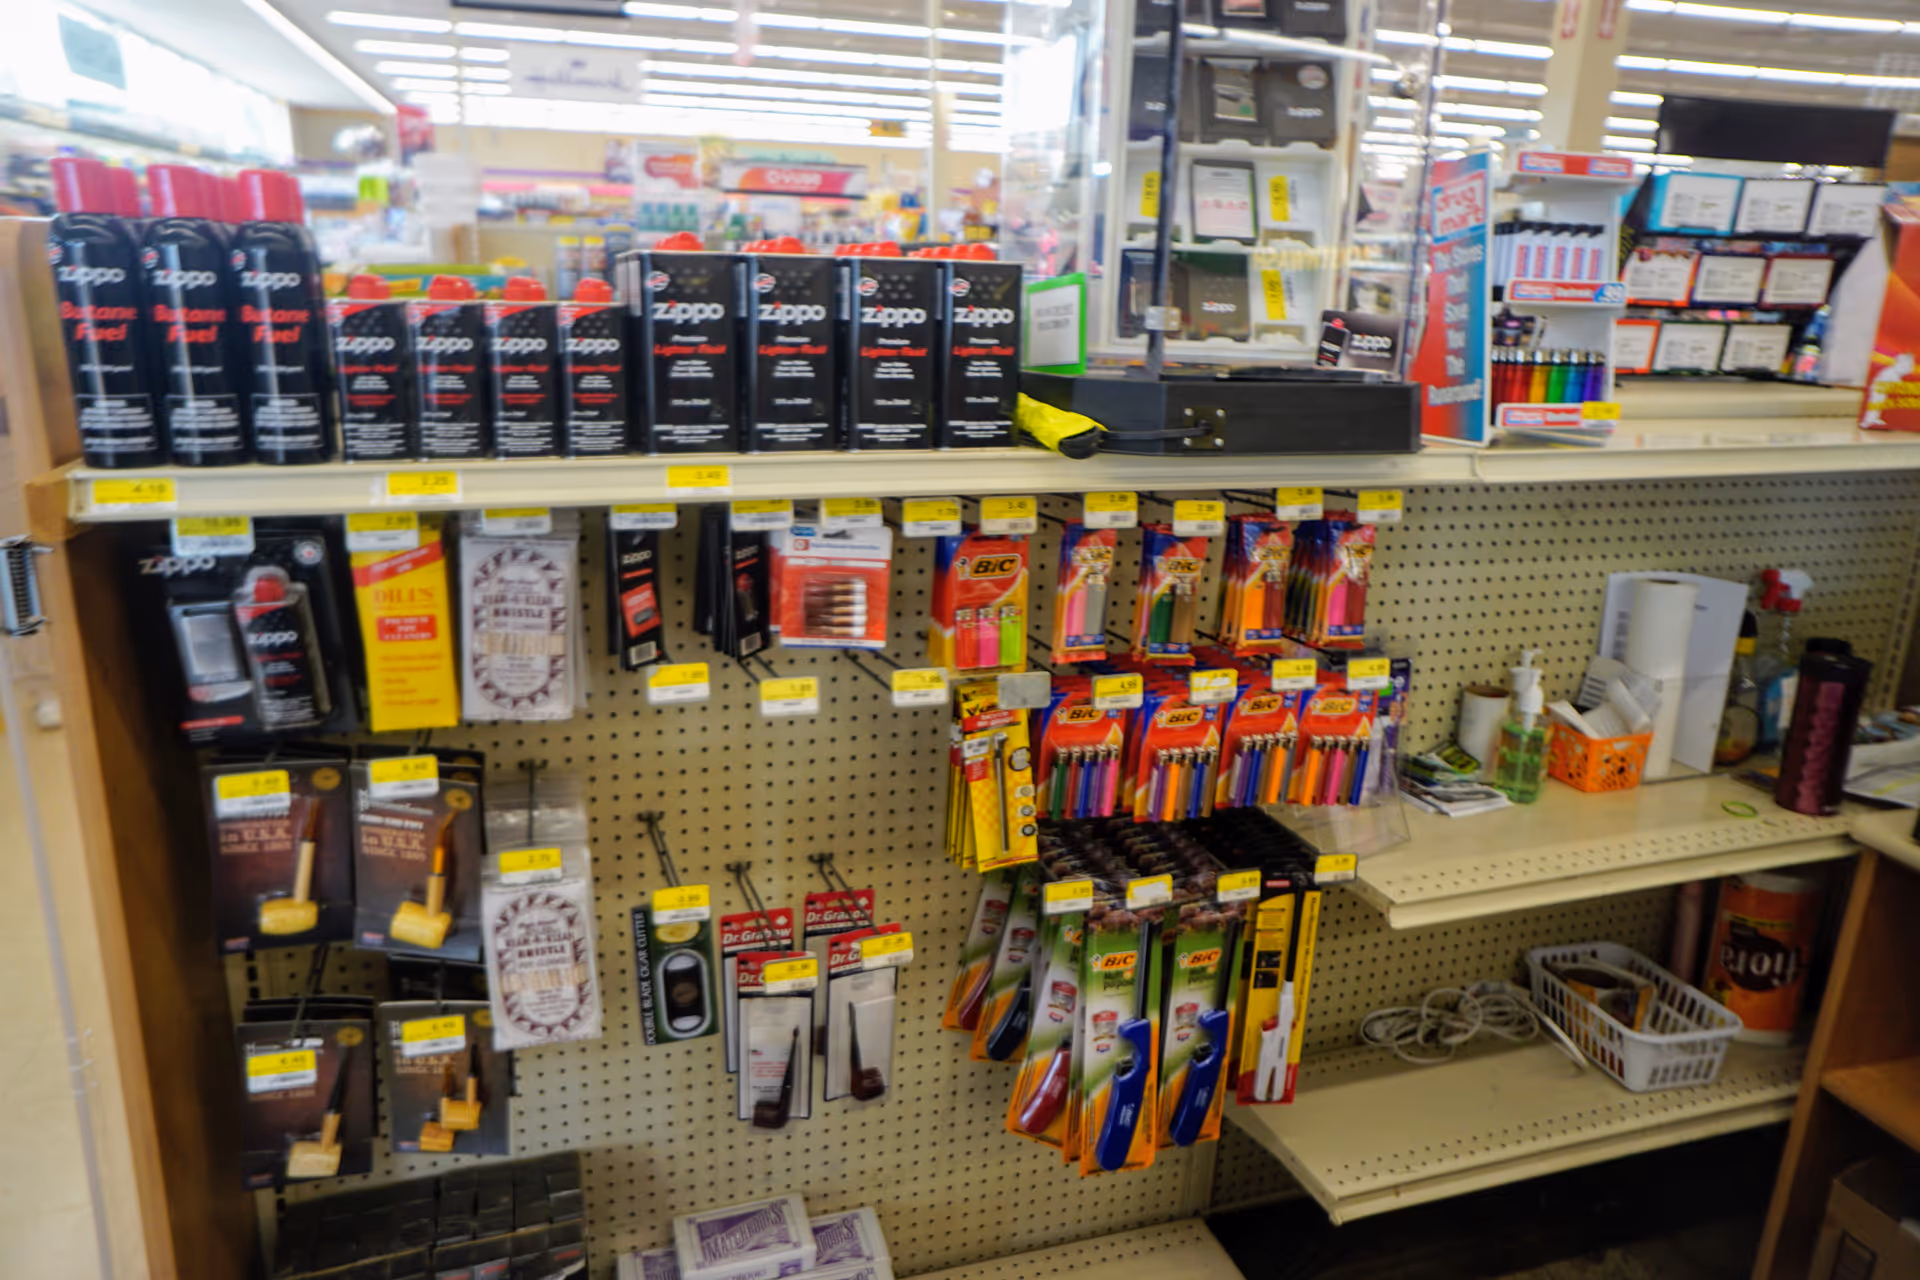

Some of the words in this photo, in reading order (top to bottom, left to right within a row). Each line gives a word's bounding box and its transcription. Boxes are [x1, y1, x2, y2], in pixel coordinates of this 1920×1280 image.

[59, 267, 126, 287] zippo
[154, 269, 217, 289] zippo
[241, 271, 302, 291] zippo
[653, 300, 725, 324] zippo
[757, 302, 827, 325] zippo
[860, 305, 928, 328] zippo
[953, 305, 1015, 328] zippo
[75, 324, 128, 341] Fuel
[168, 325, 218, 343] Fuel
[253, 325, 302, 343] Fuel
[1351, 333, 1393, 351] zippo
[336, 335, 395, 355] zippo
[415, 334, 474, 355] zippo
[493, 336, 548, 354] zippo
[565, 336, 620, 353] zippo
[139, 556, 217, 577] zippo
[248, 631, 298, 646] zippo
